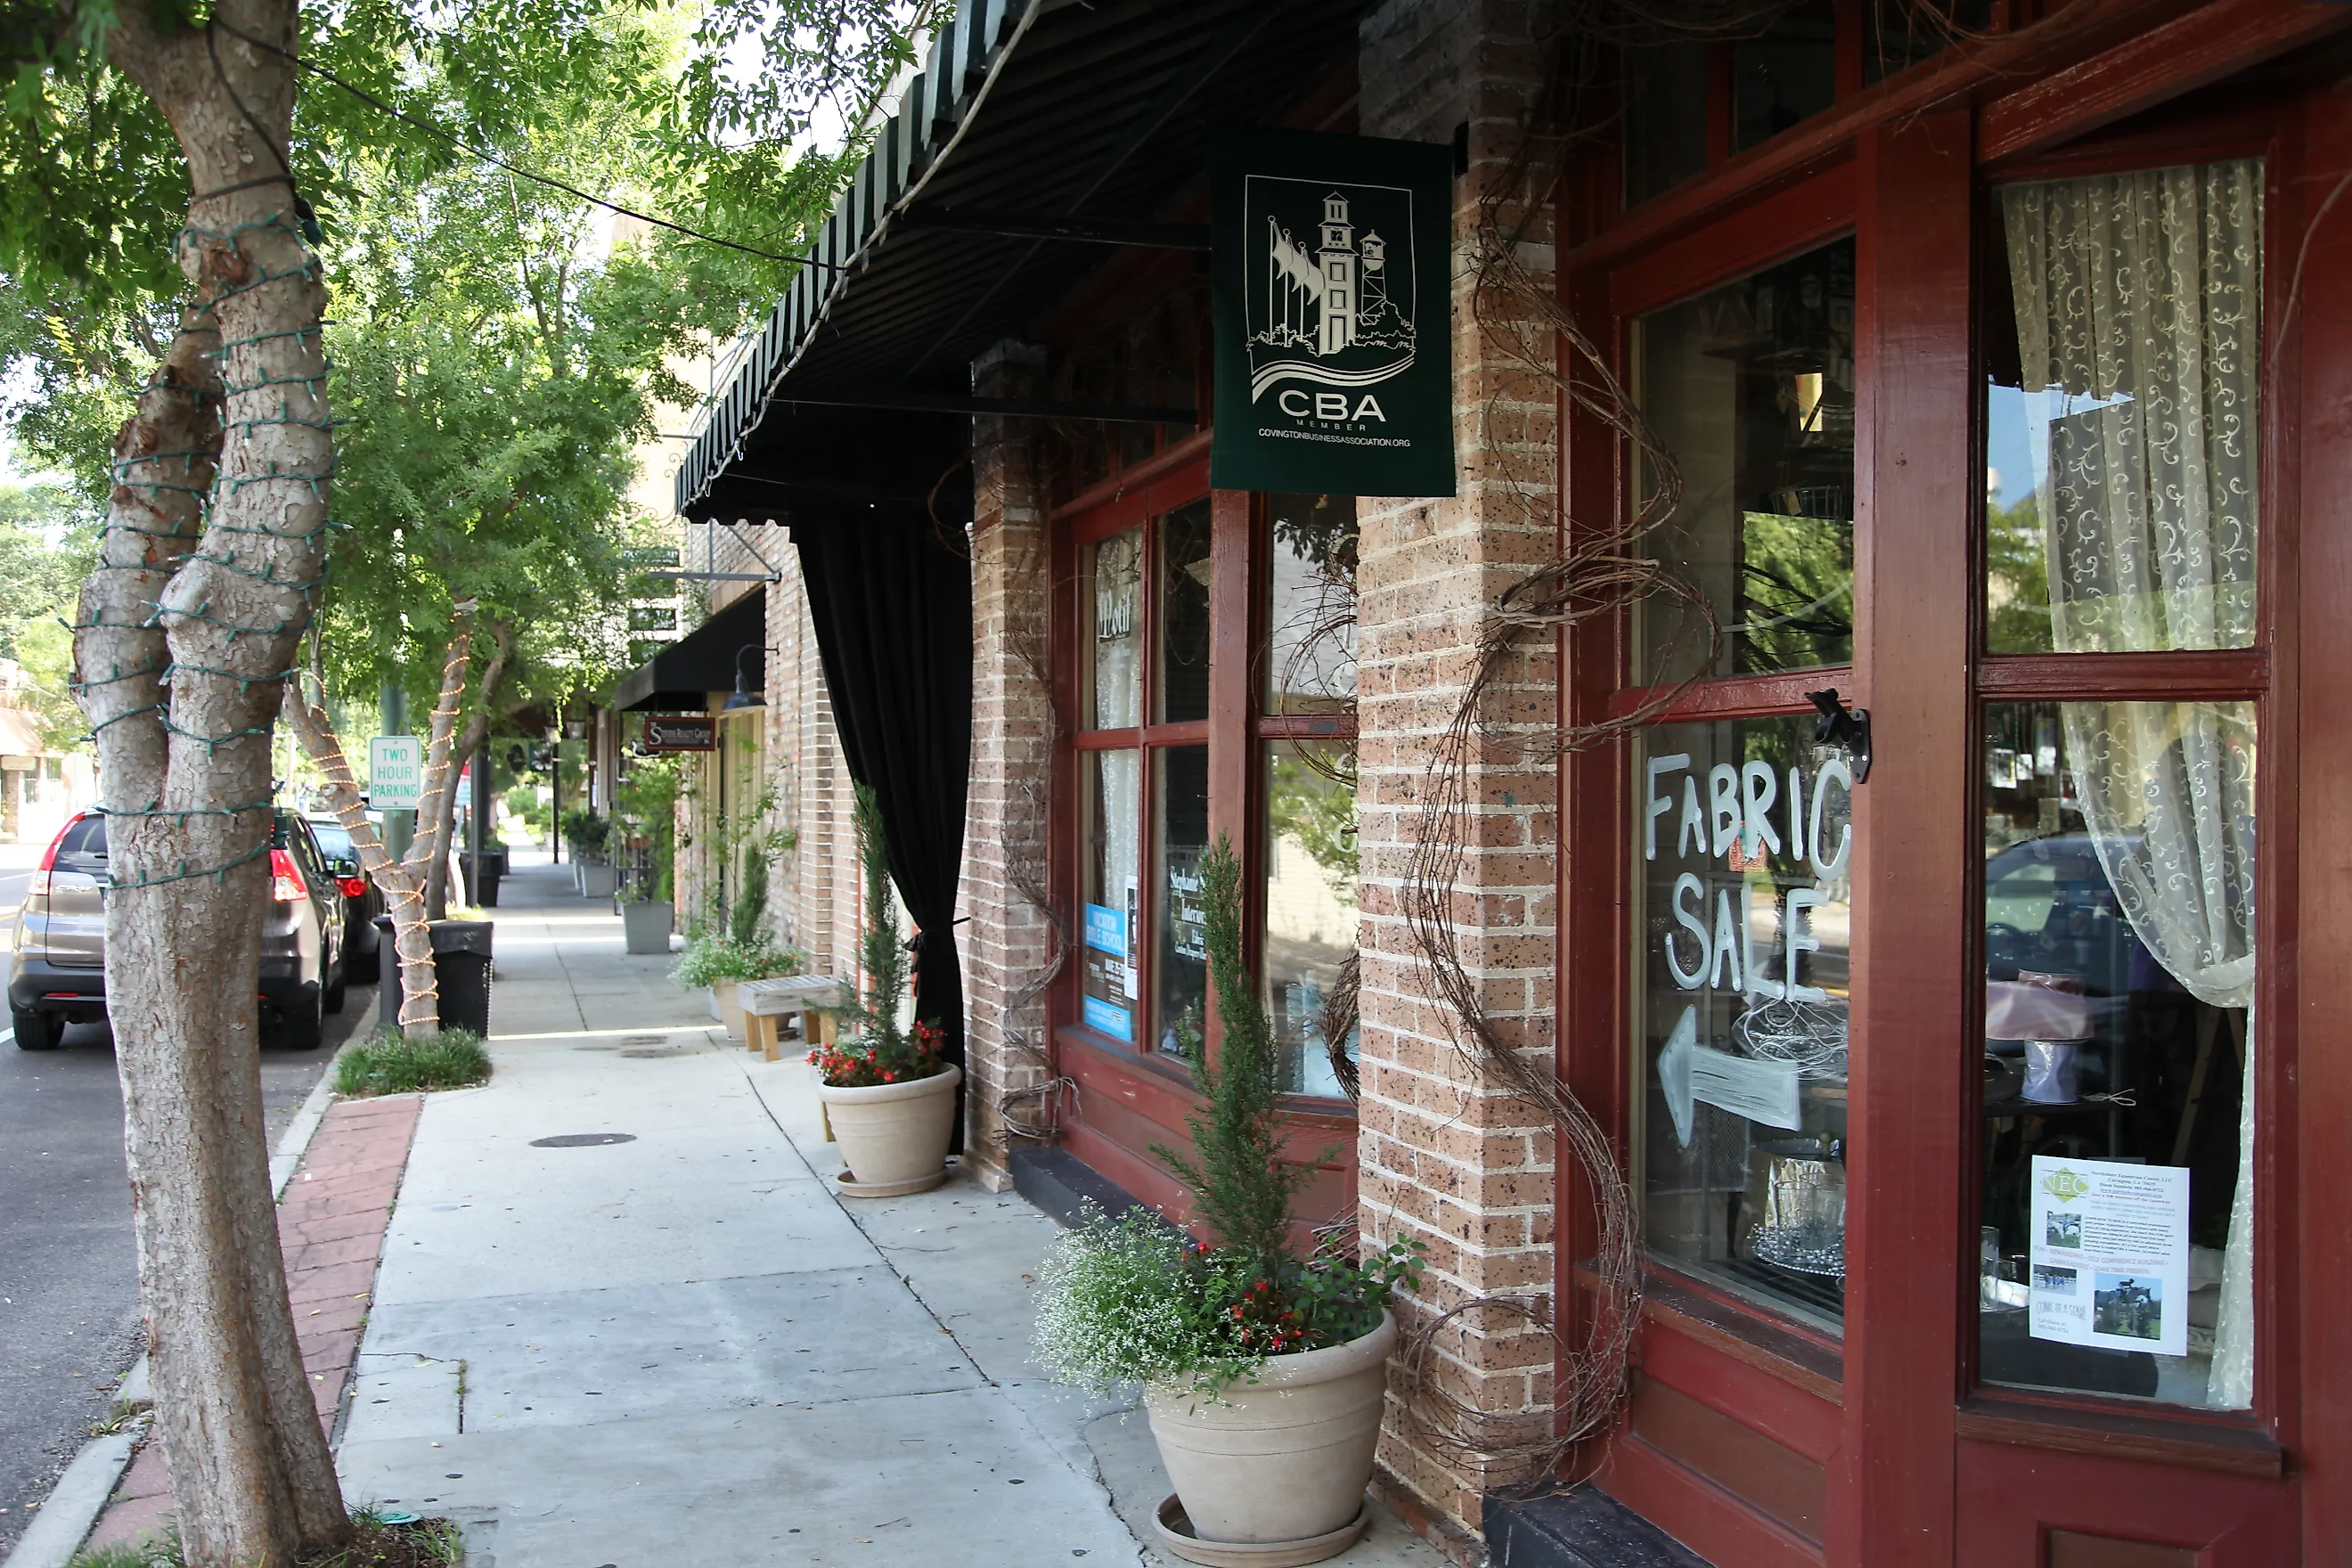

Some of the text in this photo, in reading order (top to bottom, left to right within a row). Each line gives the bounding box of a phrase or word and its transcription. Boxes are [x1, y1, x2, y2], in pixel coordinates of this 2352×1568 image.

[1278, 389, 1387, 422] CBA
[1296, 419, 1367, 431] MEMBER
[1258, 428, 1411, 447] COVINGTONBUSINESSASSOCIATION.ORG
[381, 748, 408, 762] TWO
[378, 766, 412, 780] HOUR
[373, 784, 417, 797] PARKING
[1646, 753, 1852, 881] FABRIC
[1665, 871, 1830, 1003] SALE
[2041, 1175, 2088, 1194] NEC
